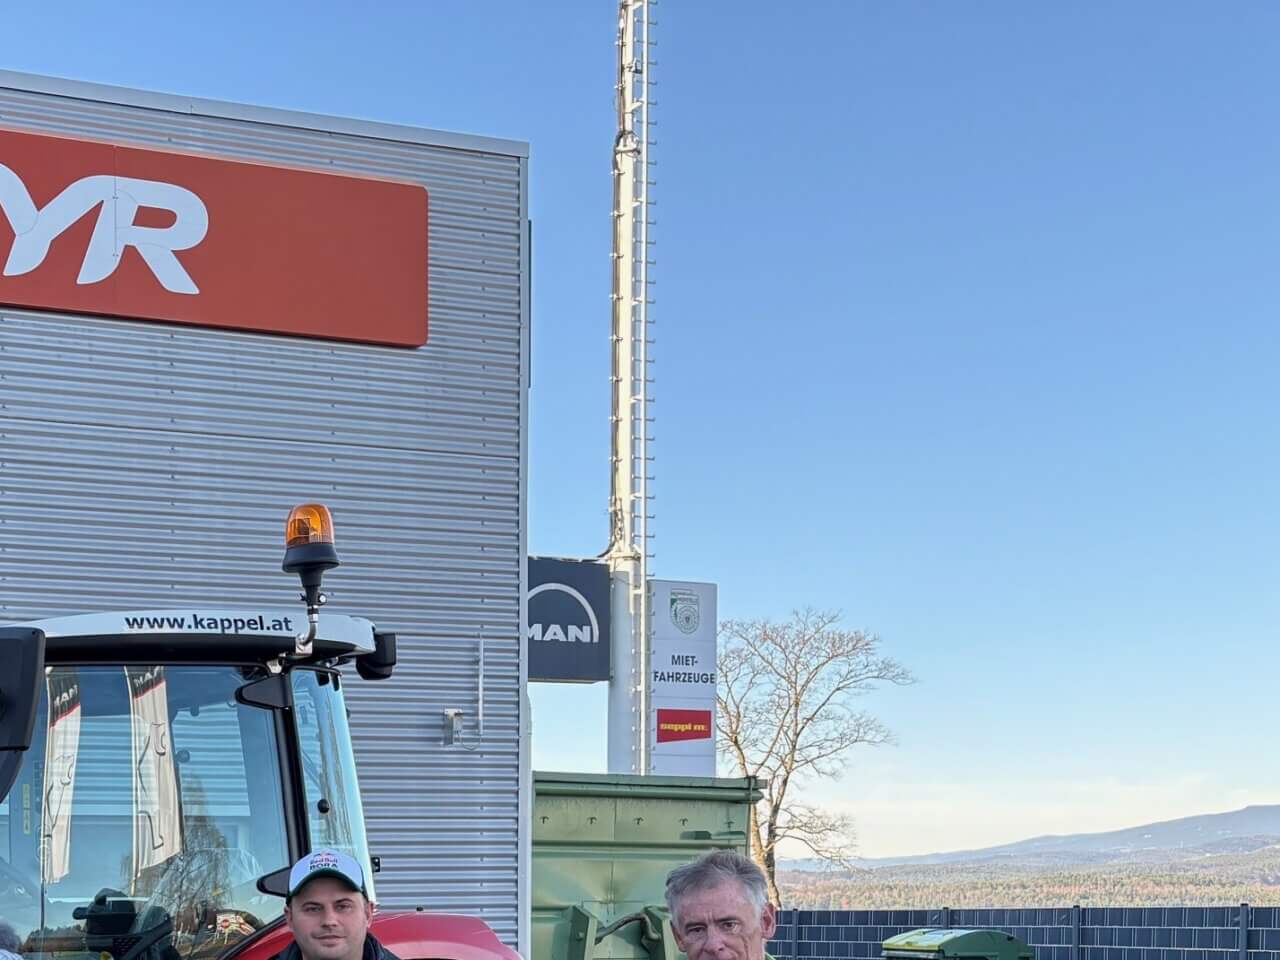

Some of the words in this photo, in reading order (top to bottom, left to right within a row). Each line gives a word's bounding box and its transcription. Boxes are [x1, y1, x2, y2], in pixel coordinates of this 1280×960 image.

[125, 614, 293, 633] www.kappel.at
[528, 623, 591, 643] MAN
[671, 654, 699, 667] MIET-
[653, 671, 716, 684] FAHRZEUGE
